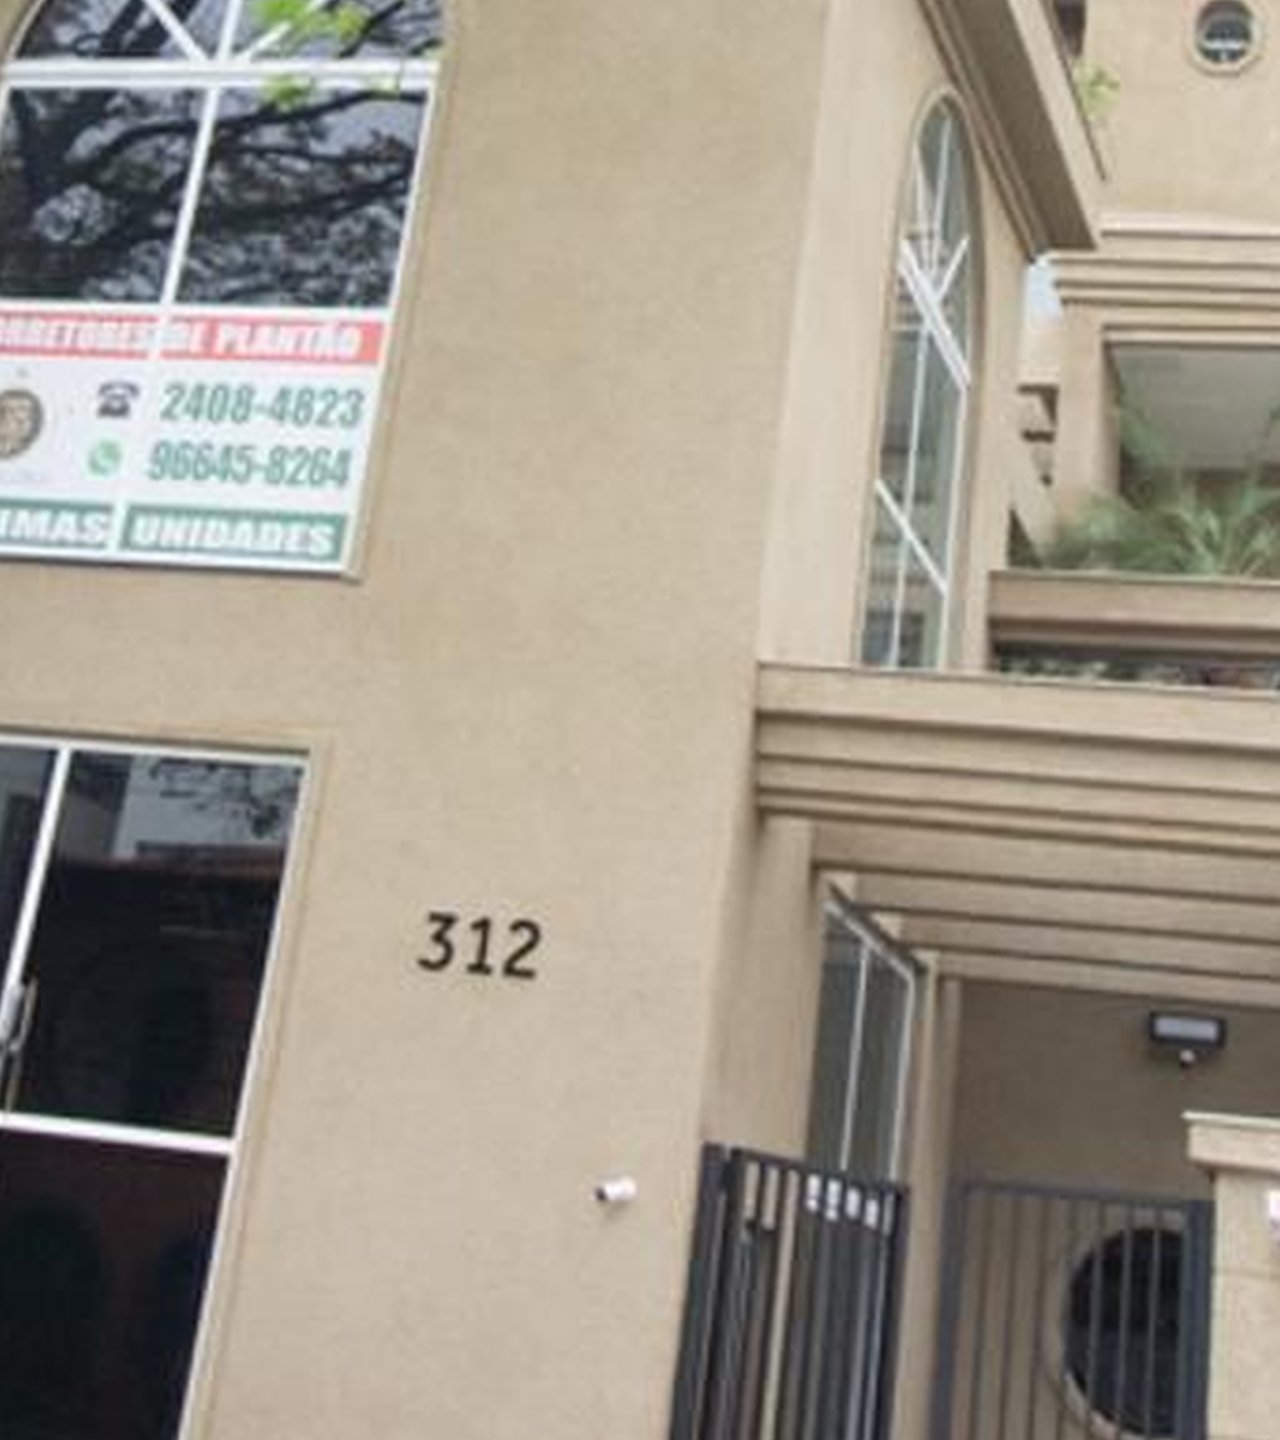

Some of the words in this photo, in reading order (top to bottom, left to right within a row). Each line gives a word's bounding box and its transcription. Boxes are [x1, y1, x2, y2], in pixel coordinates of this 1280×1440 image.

[160, 320, 210, 357] DE
[213, 317, 363, 362] PLANTÃO
[160, 381, 365, 429] 2408-4823
[147, 439, 354, 489] 96645-8264
[131, 509, 337, 558] UNIDADES
[417, 910, 543, 980] 312
